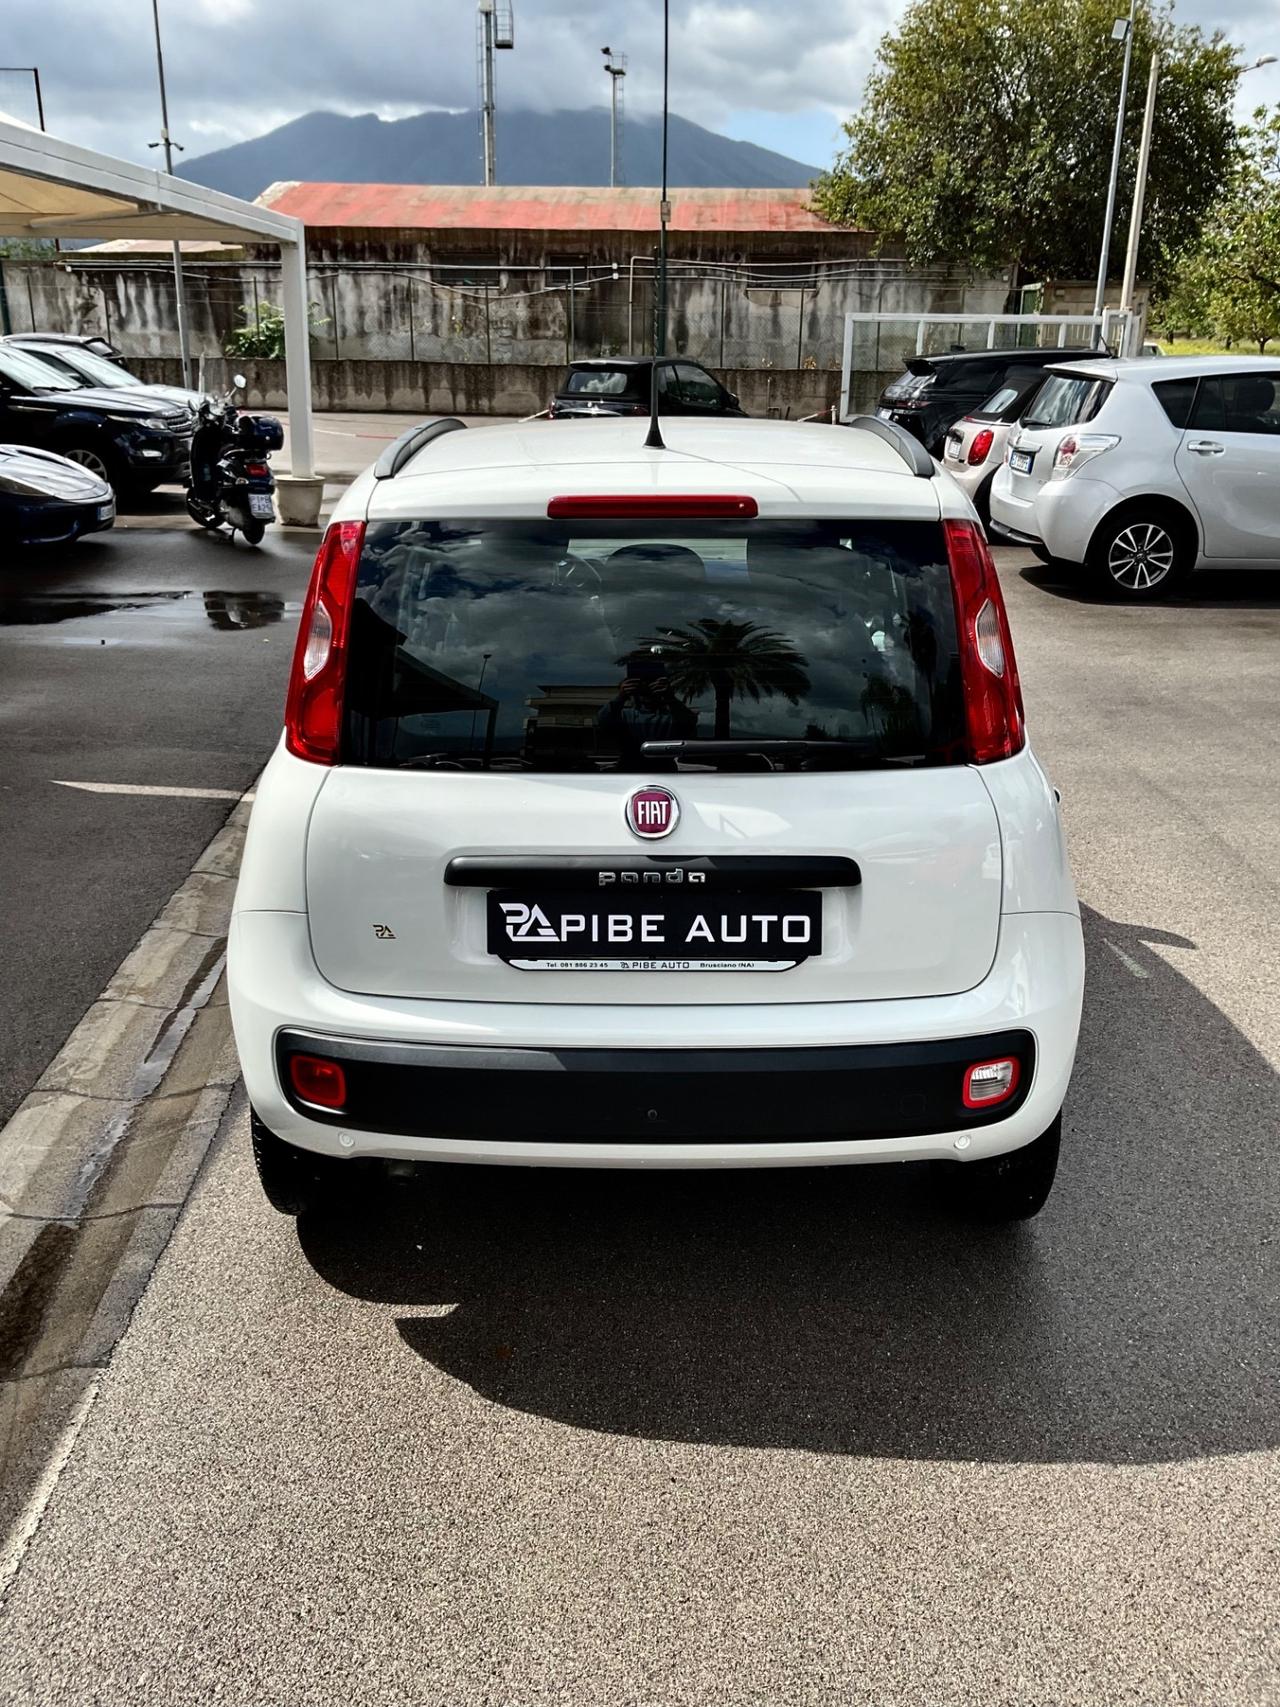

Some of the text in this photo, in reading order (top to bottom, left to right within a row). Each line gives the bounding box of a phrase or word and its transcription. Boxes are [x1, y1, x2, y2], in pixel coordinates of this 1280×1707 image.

[637, 801, 669, 825] FIAT
[598, 867, 706, 886] panda
[561, 914, 666, 942] PIBE
[684, 914, 811, 943] AUTO
